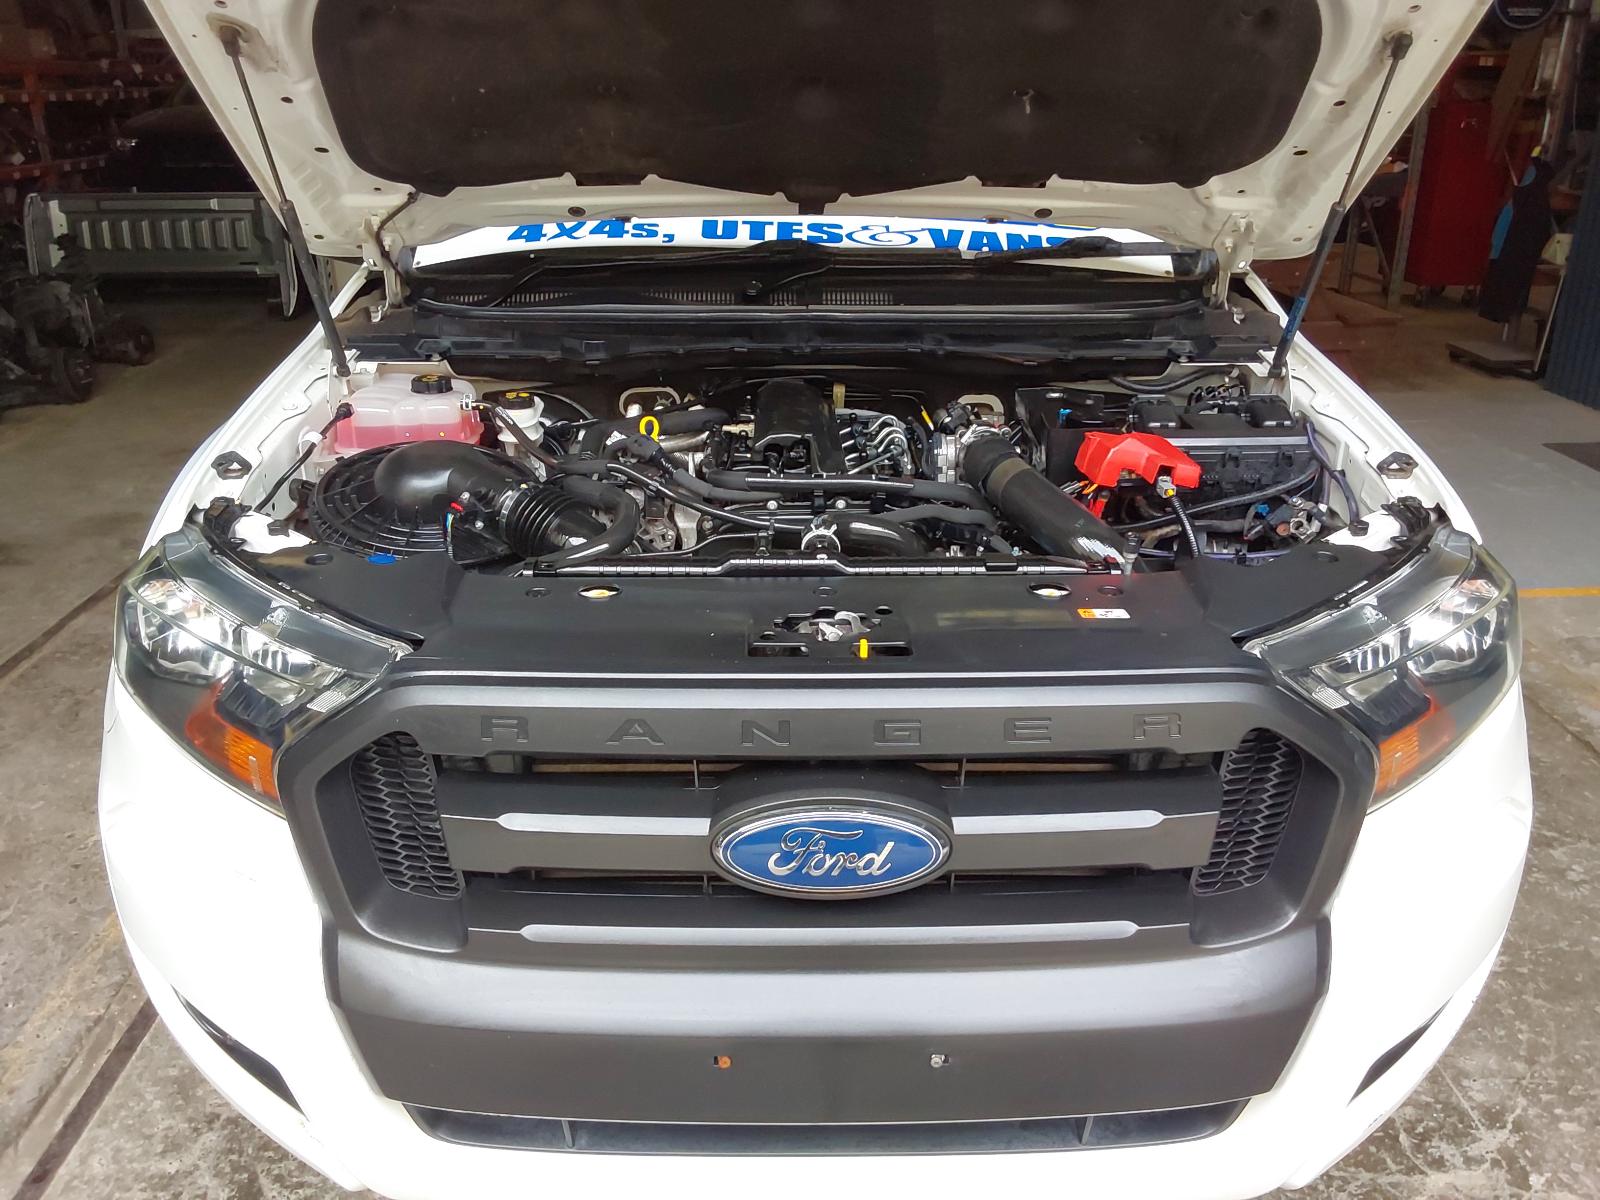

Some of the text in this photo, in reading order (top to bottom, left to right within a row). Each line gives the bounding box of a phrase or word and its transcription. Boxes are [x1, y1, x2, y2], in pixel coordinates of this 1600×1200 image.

[701, 219, 844, 244] UTES
[845, 224, 924, 247] &
[480, 712, 1182, 747] RANGER
[767, 826, 896, 877] Ford
